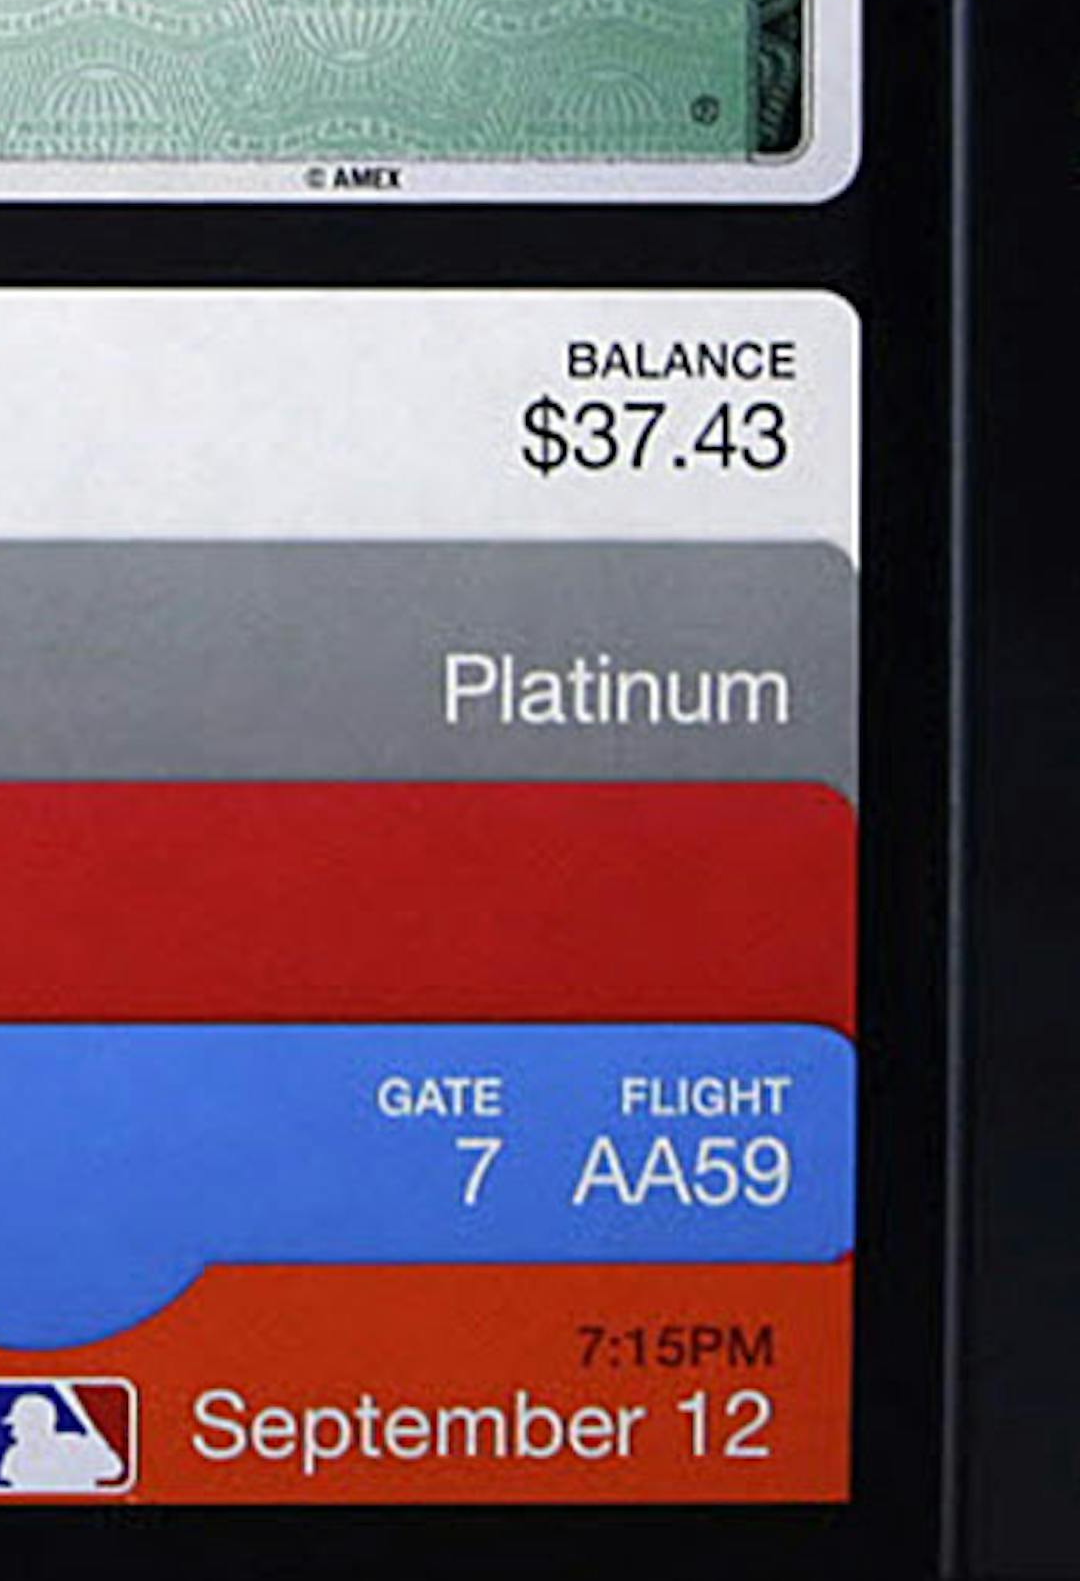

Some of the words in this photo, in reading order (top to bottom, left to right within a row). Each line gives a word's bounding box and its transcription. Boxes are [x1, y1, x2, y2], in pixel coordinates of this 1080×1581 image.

[332, 167, 402, 190] AMEX
[567, 341, 797, 381] BALANCE
[522, 394, 788, 477] $37.43
[445, 653, 789, 724] Platinum
[377, 1077, 503, 1118] GATE
[621, 1076, 792, 1118] FLIGHT
[455, 1137, 502, 1206] 7
[572, 1135, 791, 1206] AA59
[578, 1324, 775, 1369] 7:15PM
[191, 1388, 647, 1477] September
[676, 1389, 773, 1460] 12
